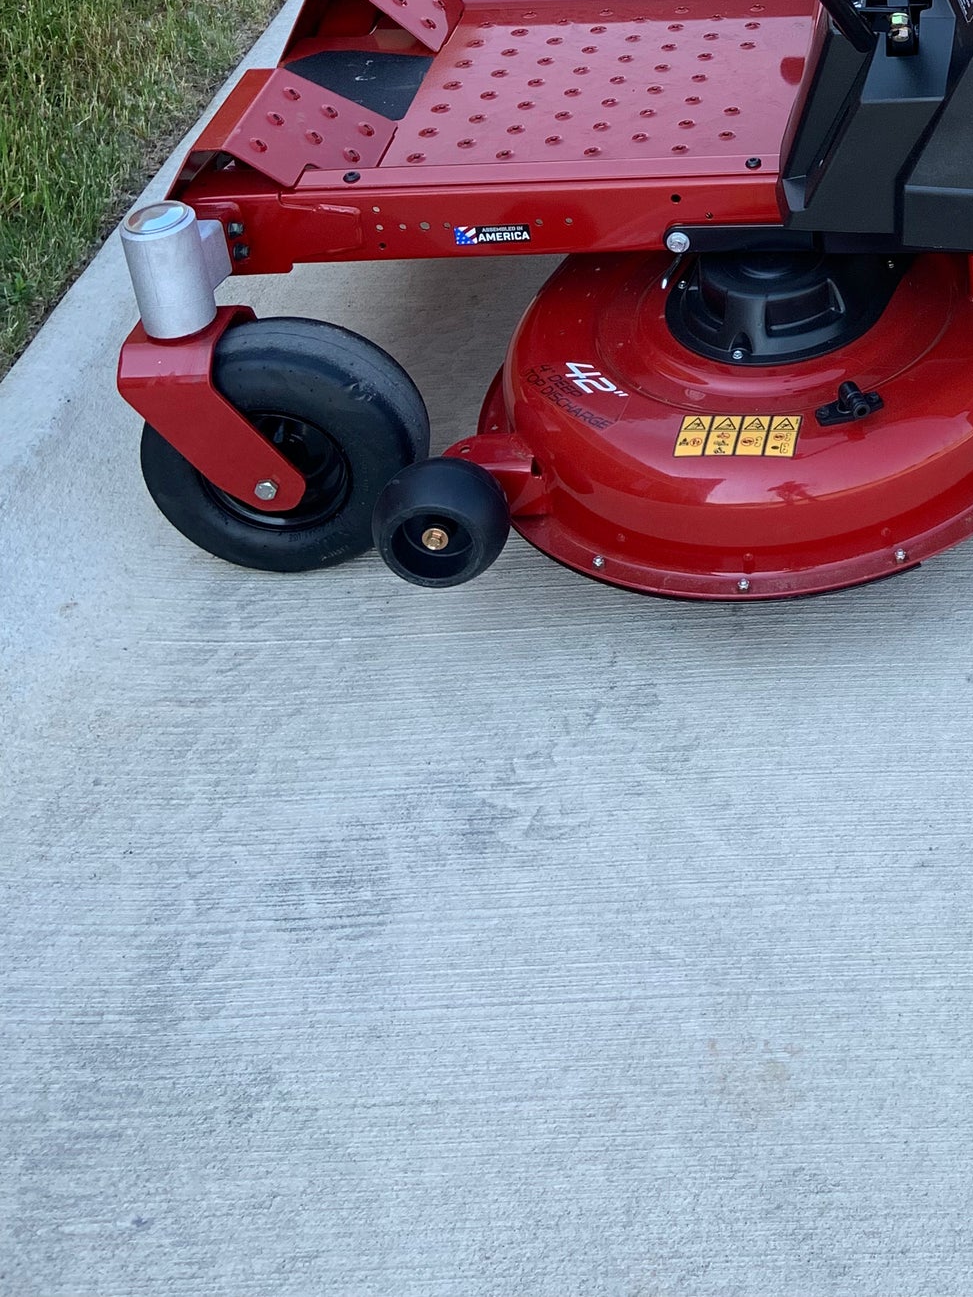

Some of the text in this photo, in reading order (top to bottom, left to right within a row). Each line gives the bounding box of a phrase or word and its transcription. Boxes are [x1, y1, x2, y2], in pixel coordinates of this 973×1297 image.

[478, 231, 530, 242] AMERICA
[548, 374, 583, 397] DEEP
[523, 367, 610, 430] TOP DISCHARGE
